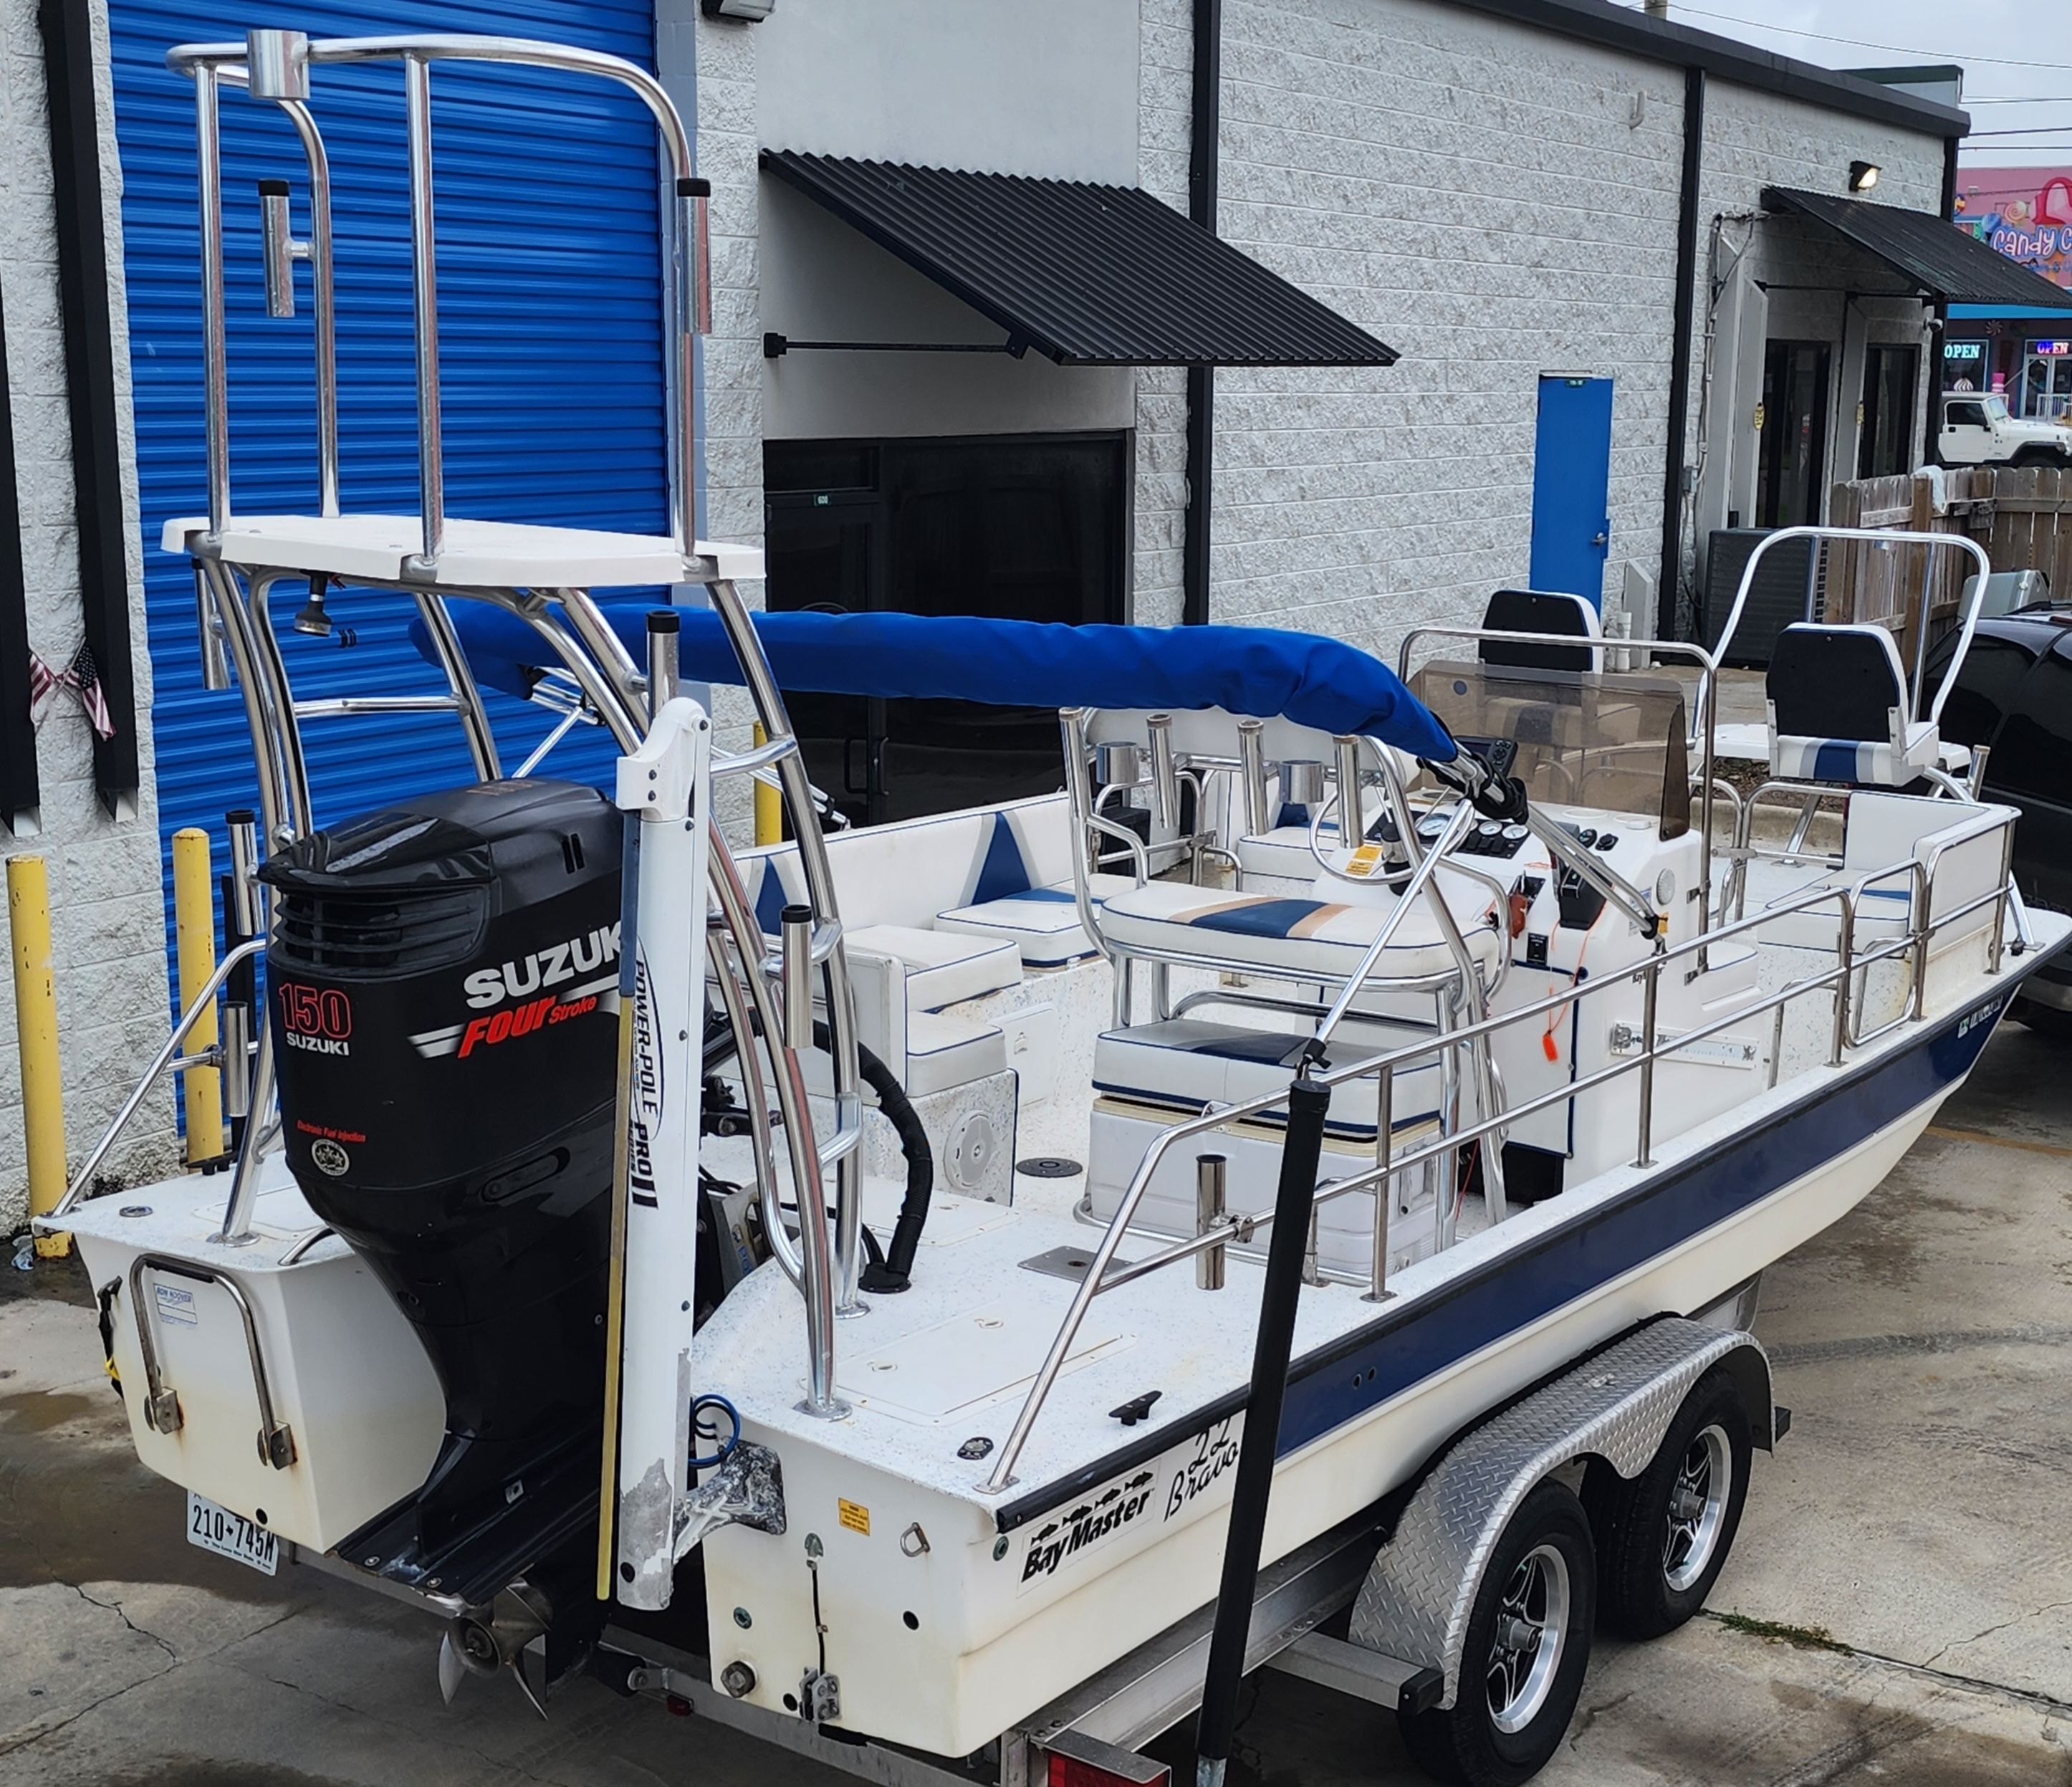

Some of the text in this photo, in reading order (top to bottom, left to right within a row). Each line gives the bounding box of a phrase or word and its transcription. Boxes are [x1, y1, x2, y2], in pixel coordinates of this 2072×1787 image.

[1992, 228, 2055, 256] Candy
[1944, 344, 1980, 358] OPEN
[2036, 342, 2069, 354] OPEN
[464, 920, 621, 1009] SUZUK
[279, 982, 351, 1038] 150
[548, 995, 598, 1025] Stroke
[287, 1032, 350, 1056] SUZUKI
[635, 960, 658, 1118] POWER-POLE
[633, 1121, 653, 1177] PRO
[1188, 1417, 1232, 1475] 22
[1164, 1442, 1239, 1523] Bravo
